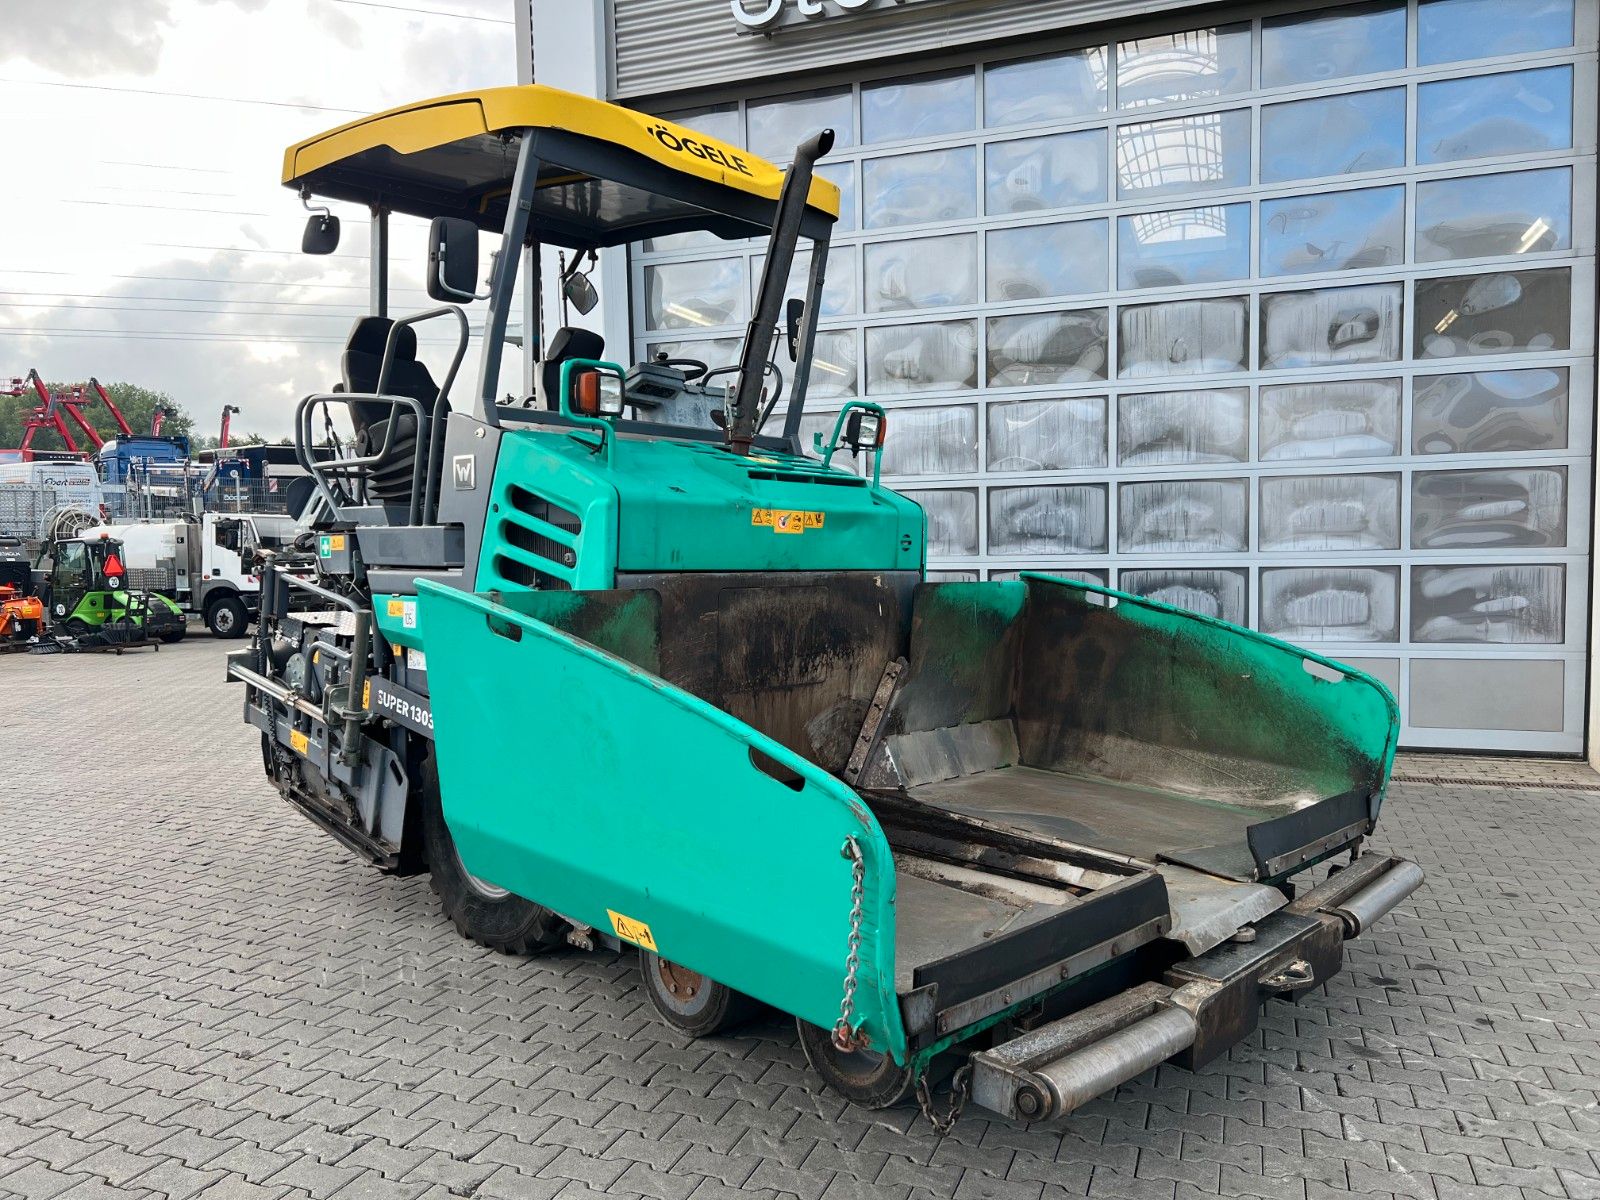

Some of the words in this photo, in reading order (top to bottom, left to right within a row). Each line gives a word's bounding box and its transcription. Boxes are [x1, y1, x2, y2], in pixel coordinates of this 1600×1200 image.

[647, 124, 754, 177] ÖGELE
[377, 689, 409, 718] SUPER
[410, 704, 434, 729] 1303
